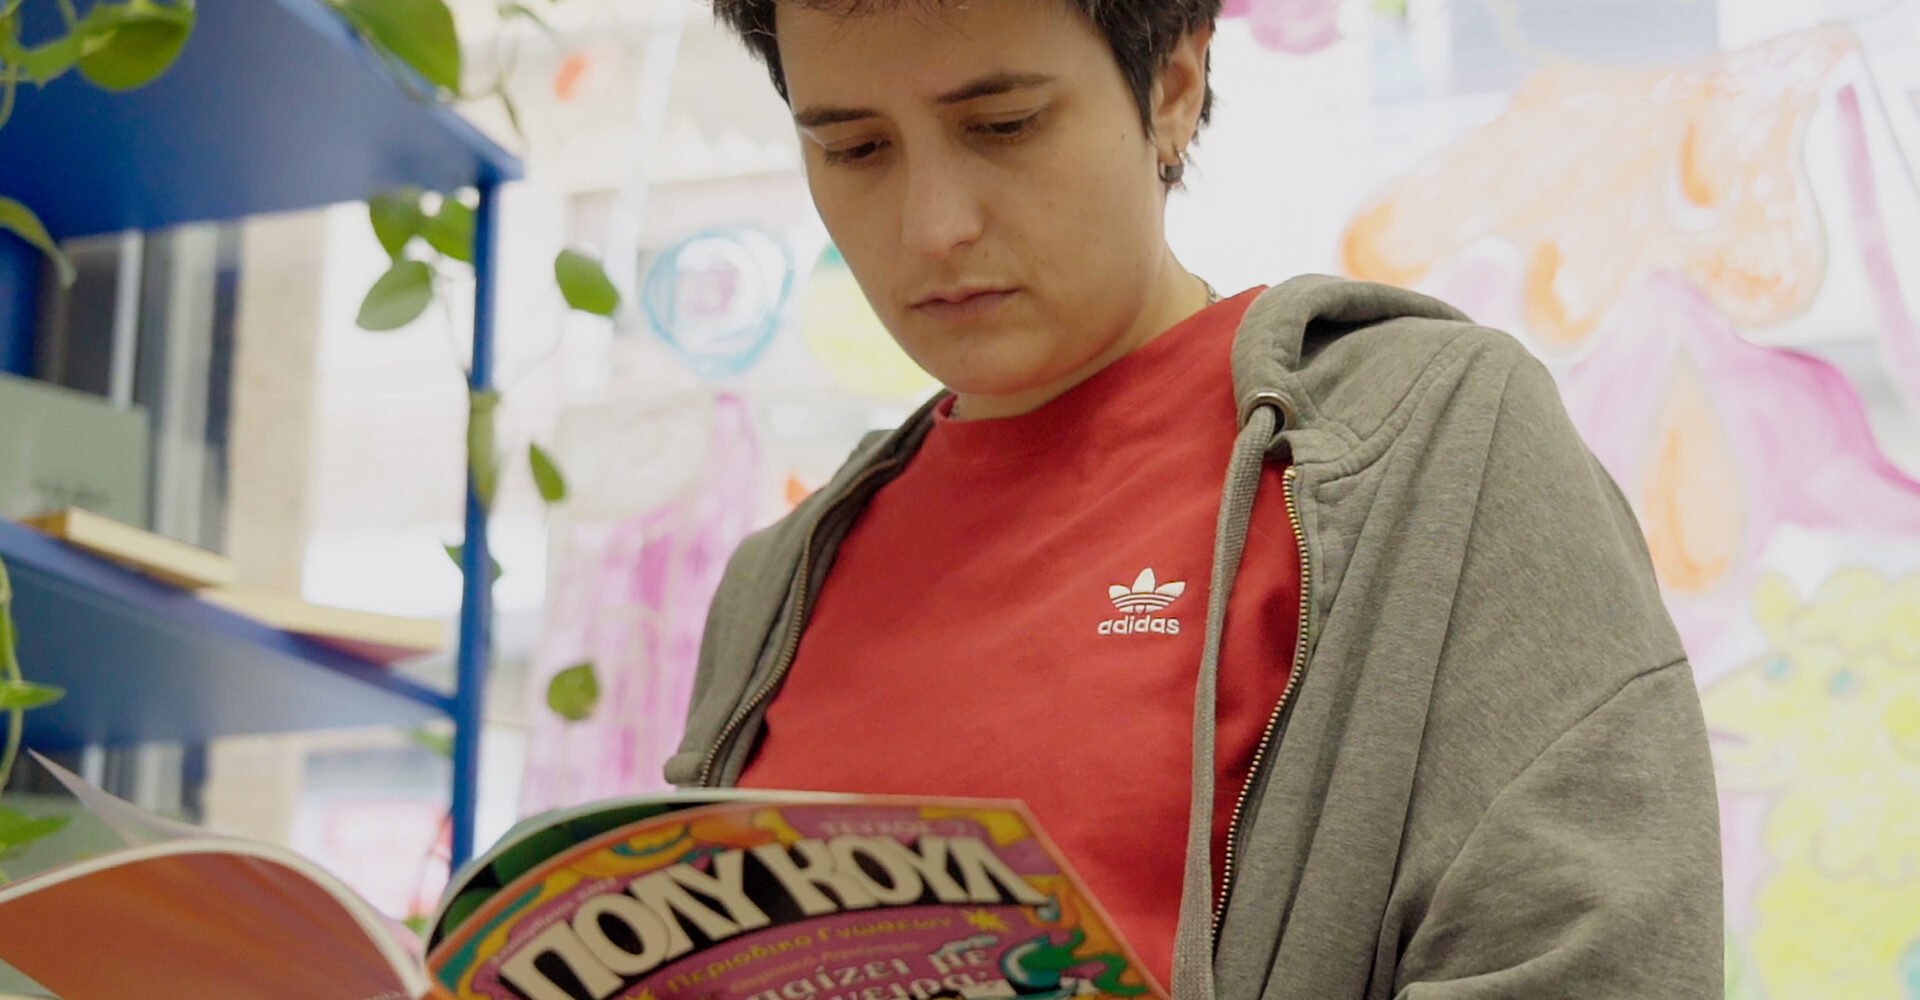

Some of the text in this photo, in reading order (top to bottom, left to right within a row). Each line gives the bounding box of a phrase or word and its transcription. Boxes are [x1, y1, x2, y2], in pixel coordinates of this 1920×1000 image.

[1097, 615, 1180, 635] adidas
[500, 848, 771, 1000] ΠΟΛΥ
[752, 834, 1053, 917] ΚΟΥΛ
